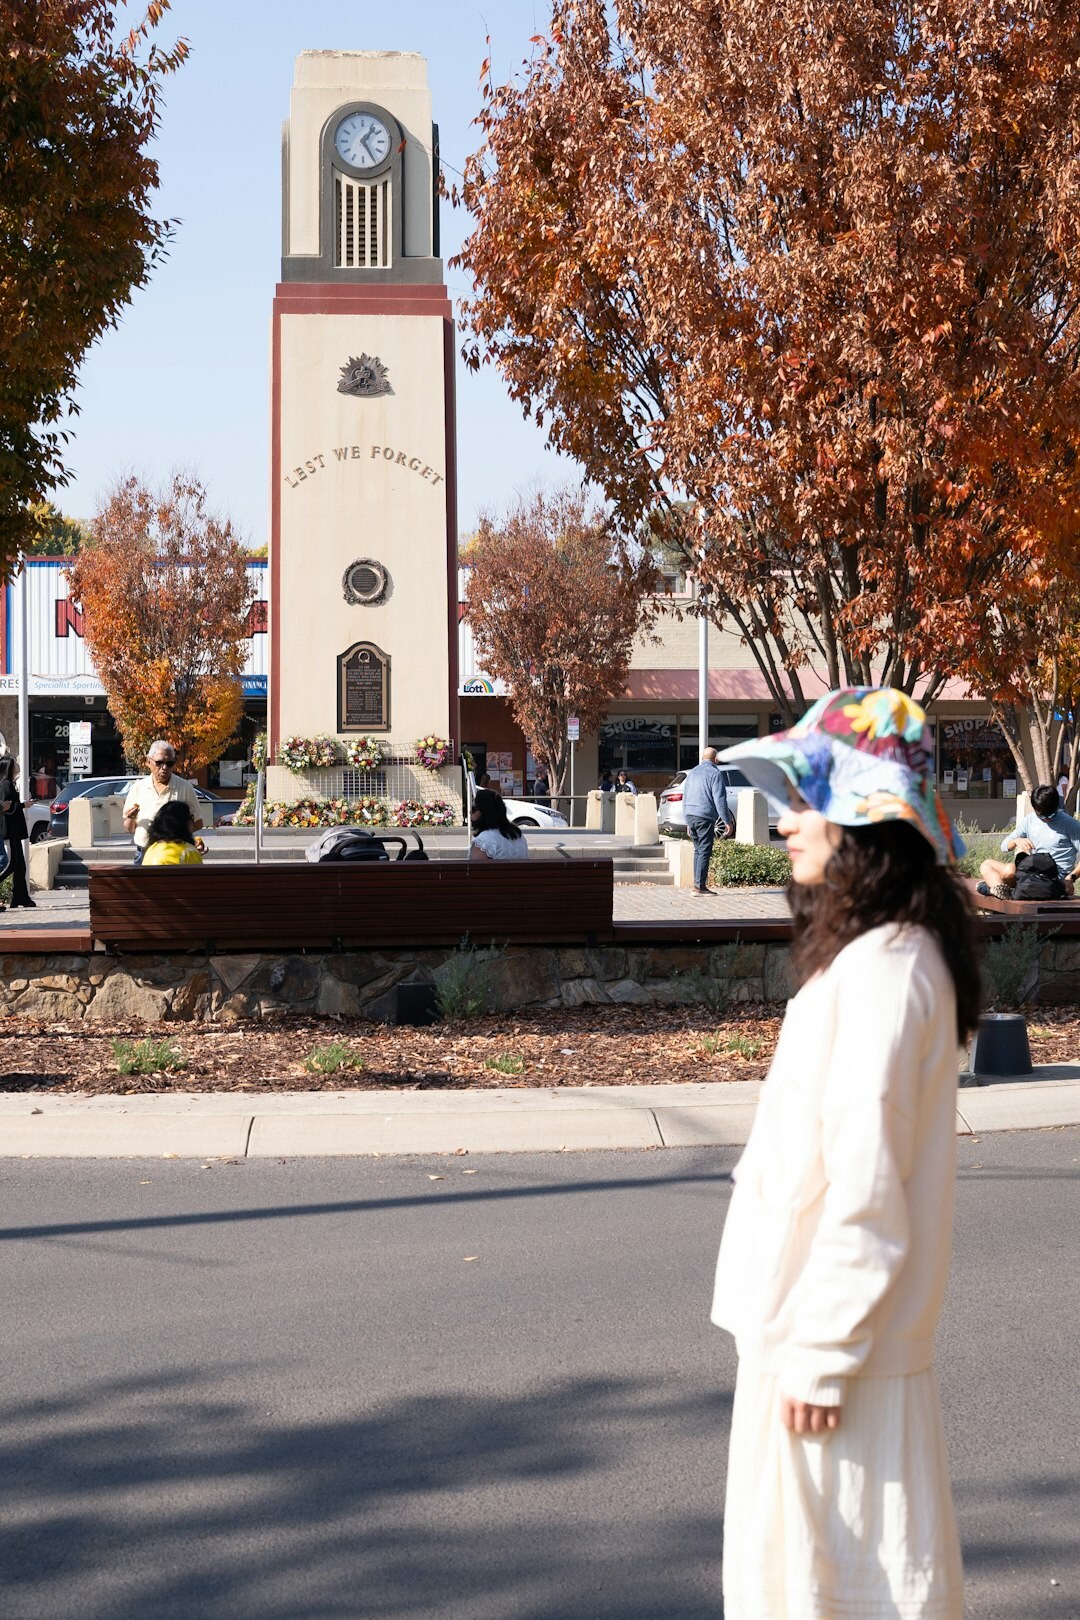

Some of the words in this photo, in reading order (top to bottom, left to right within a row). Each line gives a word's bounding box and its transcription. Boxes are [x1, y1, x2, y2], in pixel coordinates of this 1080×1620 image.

[284, 454, 326, 489] LEST
[332, 446, 361, 462] WE
[370, 446, 444, 486] FORGET
[34, 681, 70, 690] Specialist
[463, 684, 484, 693] Lott
[604, 718, 646, 738] SHOP
[650, 721, 672, 738] 26
[944, 719, 985, 738] SHOP
[73, 747, 89, 755] ONE
